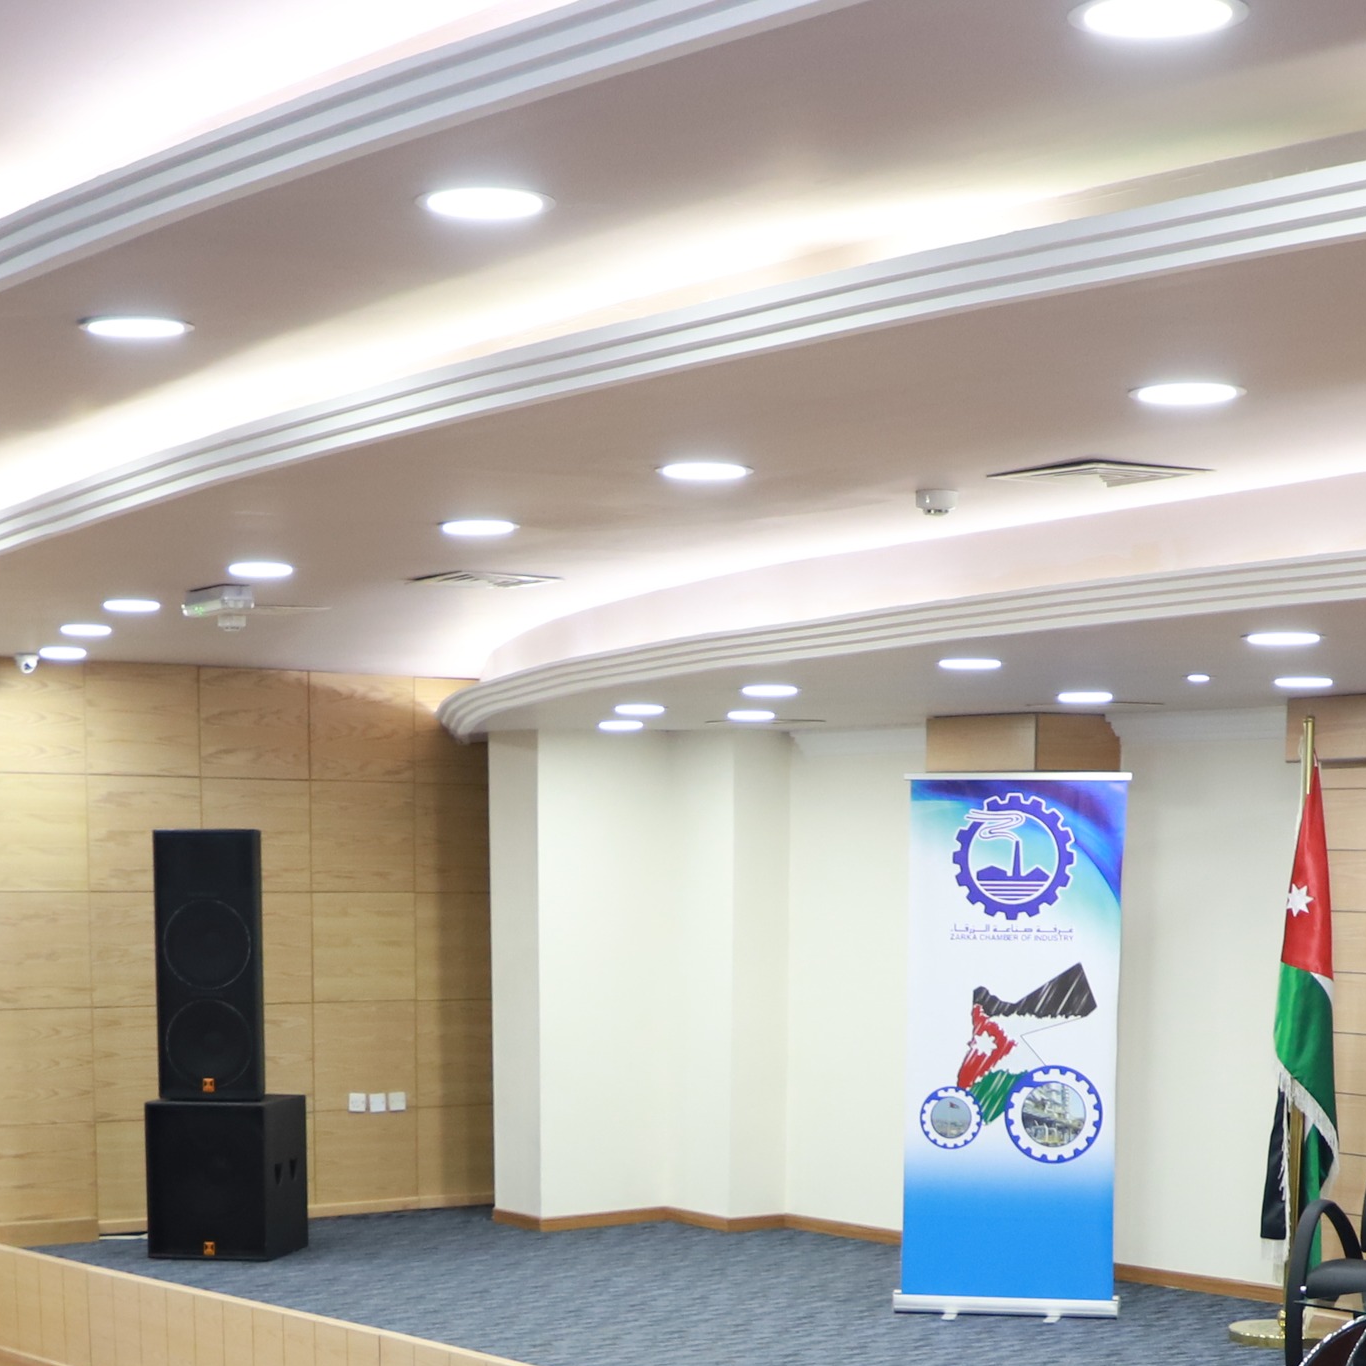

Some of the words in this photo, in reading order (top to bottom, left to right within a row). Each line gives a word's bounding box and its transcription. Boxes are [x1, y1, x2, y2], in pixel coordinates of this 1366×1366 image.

[950, 933, 977, 941] ZARKA
[979, 933, 1019, 941] CHAMBER
[1035, 934, 1074, 942] INDUSTRY
